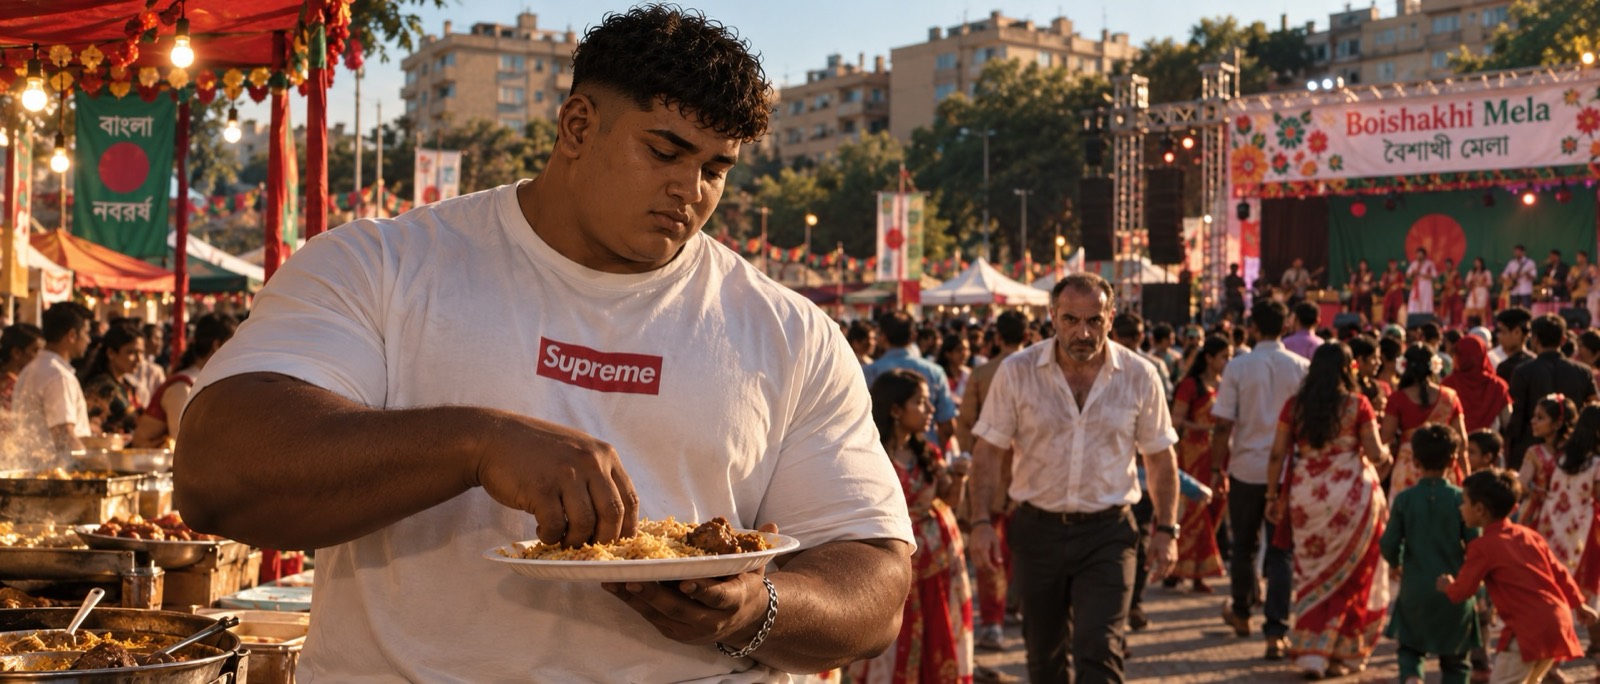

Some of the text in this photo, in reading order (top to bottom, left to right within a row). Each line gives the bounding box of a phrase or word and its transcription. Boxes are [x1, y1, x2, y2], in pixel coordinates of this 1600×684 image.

[99, 115, 154, 138] বাংলা
[1346, 96, 1550, 136] Boishakhi Mela
[1382, 133, 1510, 163] বৈশাখী মেলা
[543, 344, 656, 384] Supreme
